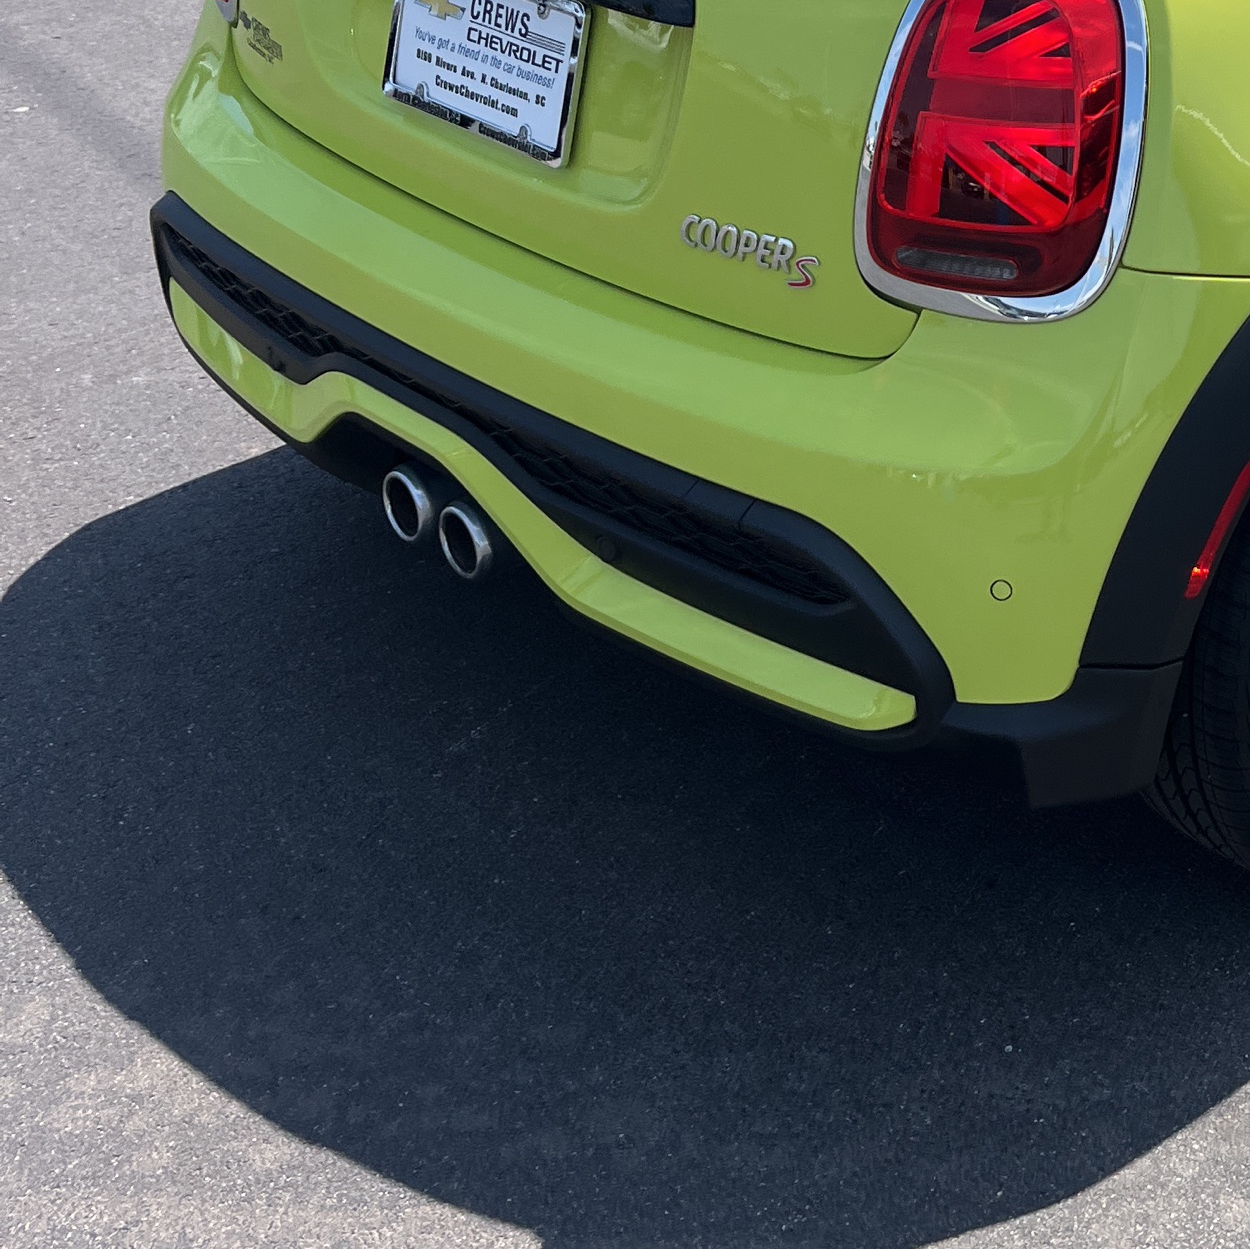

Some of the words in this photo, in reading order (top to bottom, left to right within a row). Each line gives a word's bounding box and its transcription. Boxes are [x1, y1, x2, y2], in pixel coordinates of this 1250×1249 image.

[415, 26, 436, 45] You've
[437, 37, 450, 50] got
[450, 43, 456, 52] a
[457, 42, 481, 61] friend
[480, 52, 489, 65] in
[490, 55, 502, 70] the
[503, 62, 516, 75] car
[516, 64, 556, 89] business!
[467, 26, 564, 74] CHEVROLET
[435, 55, 457, 73] Rivers
[461, 66, 477, 80] Ave.
[535, 93, 546, 107] SC
[435, 74, 519, 118] CrewsChevrolet.com
[681, 214, 796, 274] COOPER
